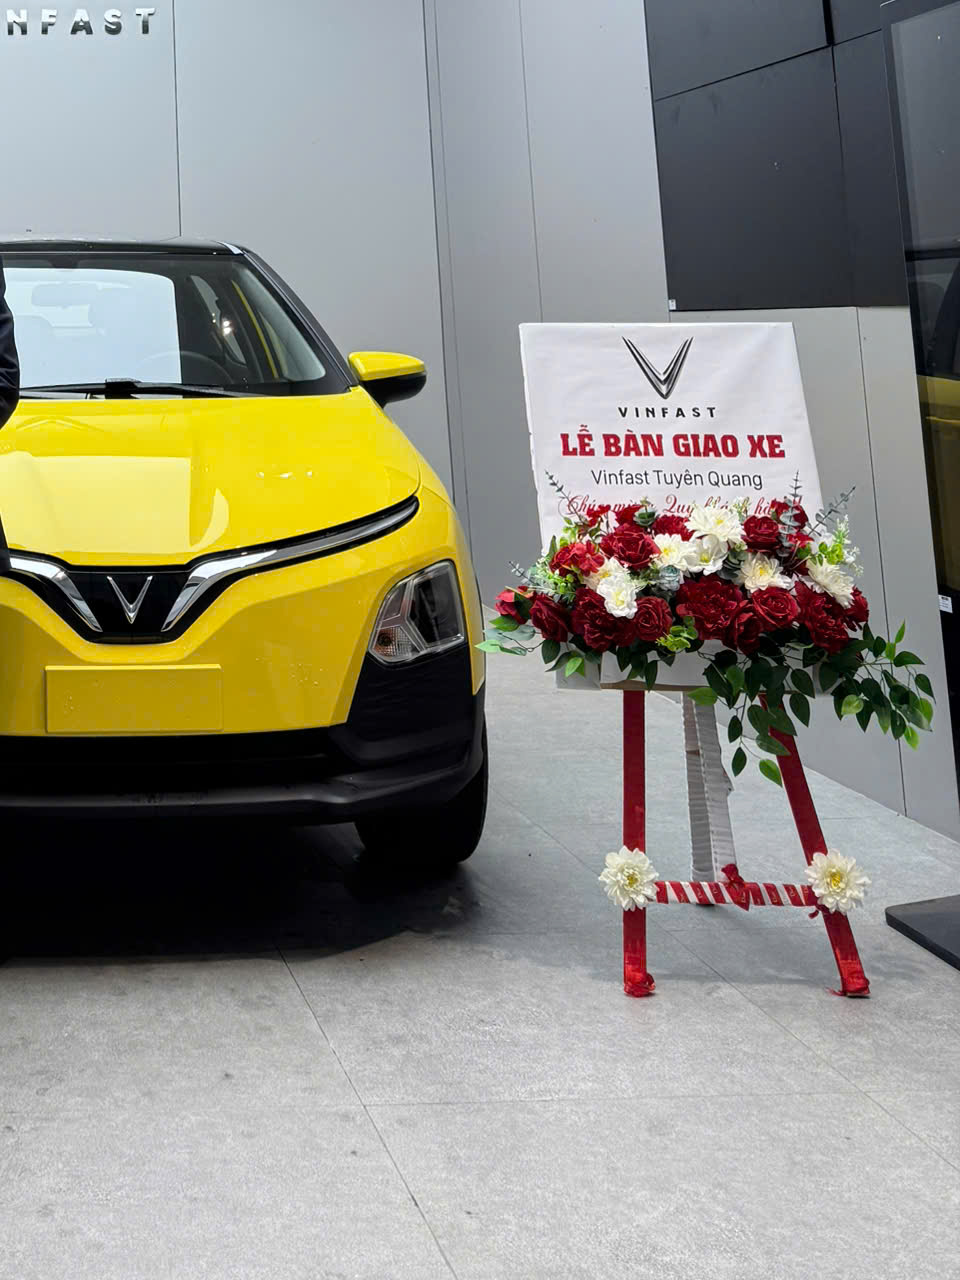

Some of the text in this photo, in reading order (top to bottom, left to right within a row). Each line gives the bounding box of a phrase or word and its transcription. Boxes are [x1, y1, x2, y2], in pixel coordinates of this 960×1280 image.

[618, 407, 716, 418] VINFAST
[560, 423, 786, 459] LỄ BÀN GIAO XE
[590, 468, 763, 491] Vinfast Tuyên Quang
